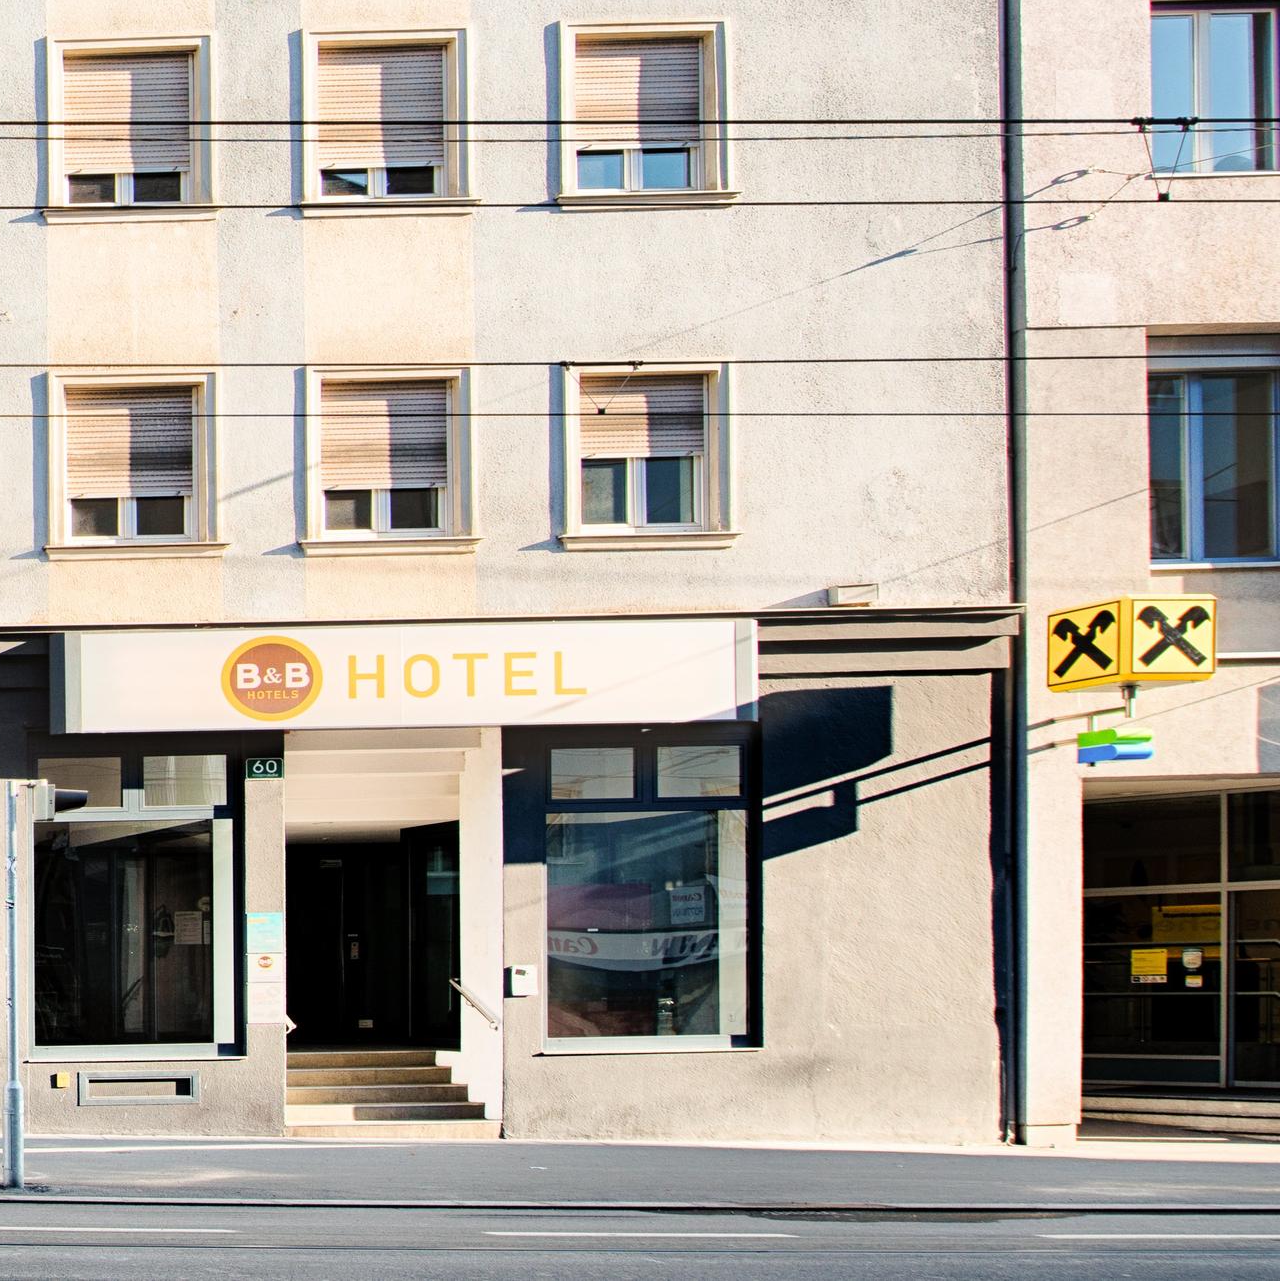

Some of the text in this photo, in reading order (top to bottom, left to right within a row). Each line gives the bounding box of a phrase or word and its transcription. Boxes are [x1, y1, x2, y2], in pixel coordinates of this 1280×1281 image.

[236, 662, 310, 689] B&B
[348, 651, 587, 699] HOTEL
[247, 690, 299, 700] HOTELS
[252, 760, 278, 774] 60
